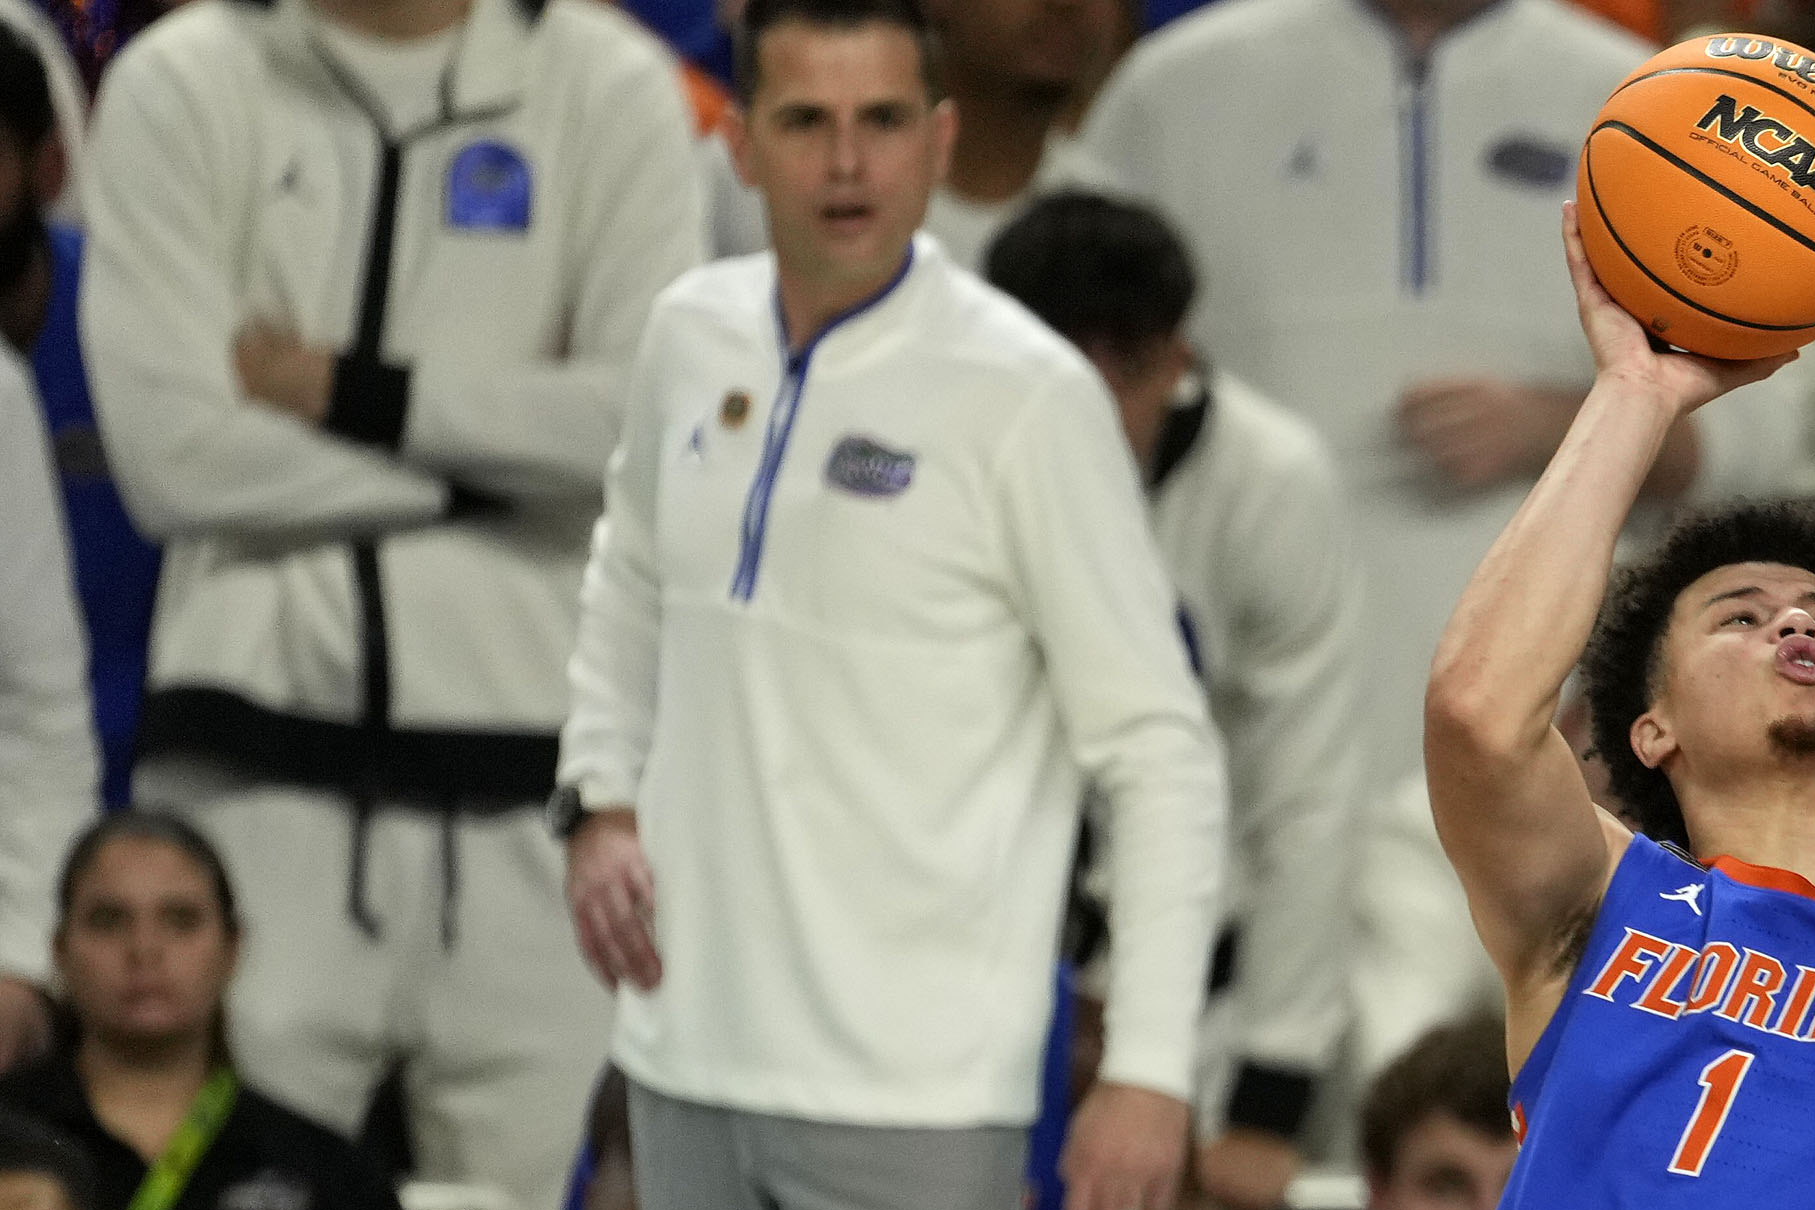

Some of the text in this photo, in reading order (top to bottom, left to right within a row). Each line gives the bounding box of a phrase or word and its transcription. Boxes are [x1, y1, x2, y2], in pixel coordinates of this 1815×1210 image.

[1778, 72, 1808, 89] EVO
[1689, 131, 1748, 165] OFFICIAL
[1751, 162, 1791, 192] GAME
[1667, 1048, 1756, 1178] 1
